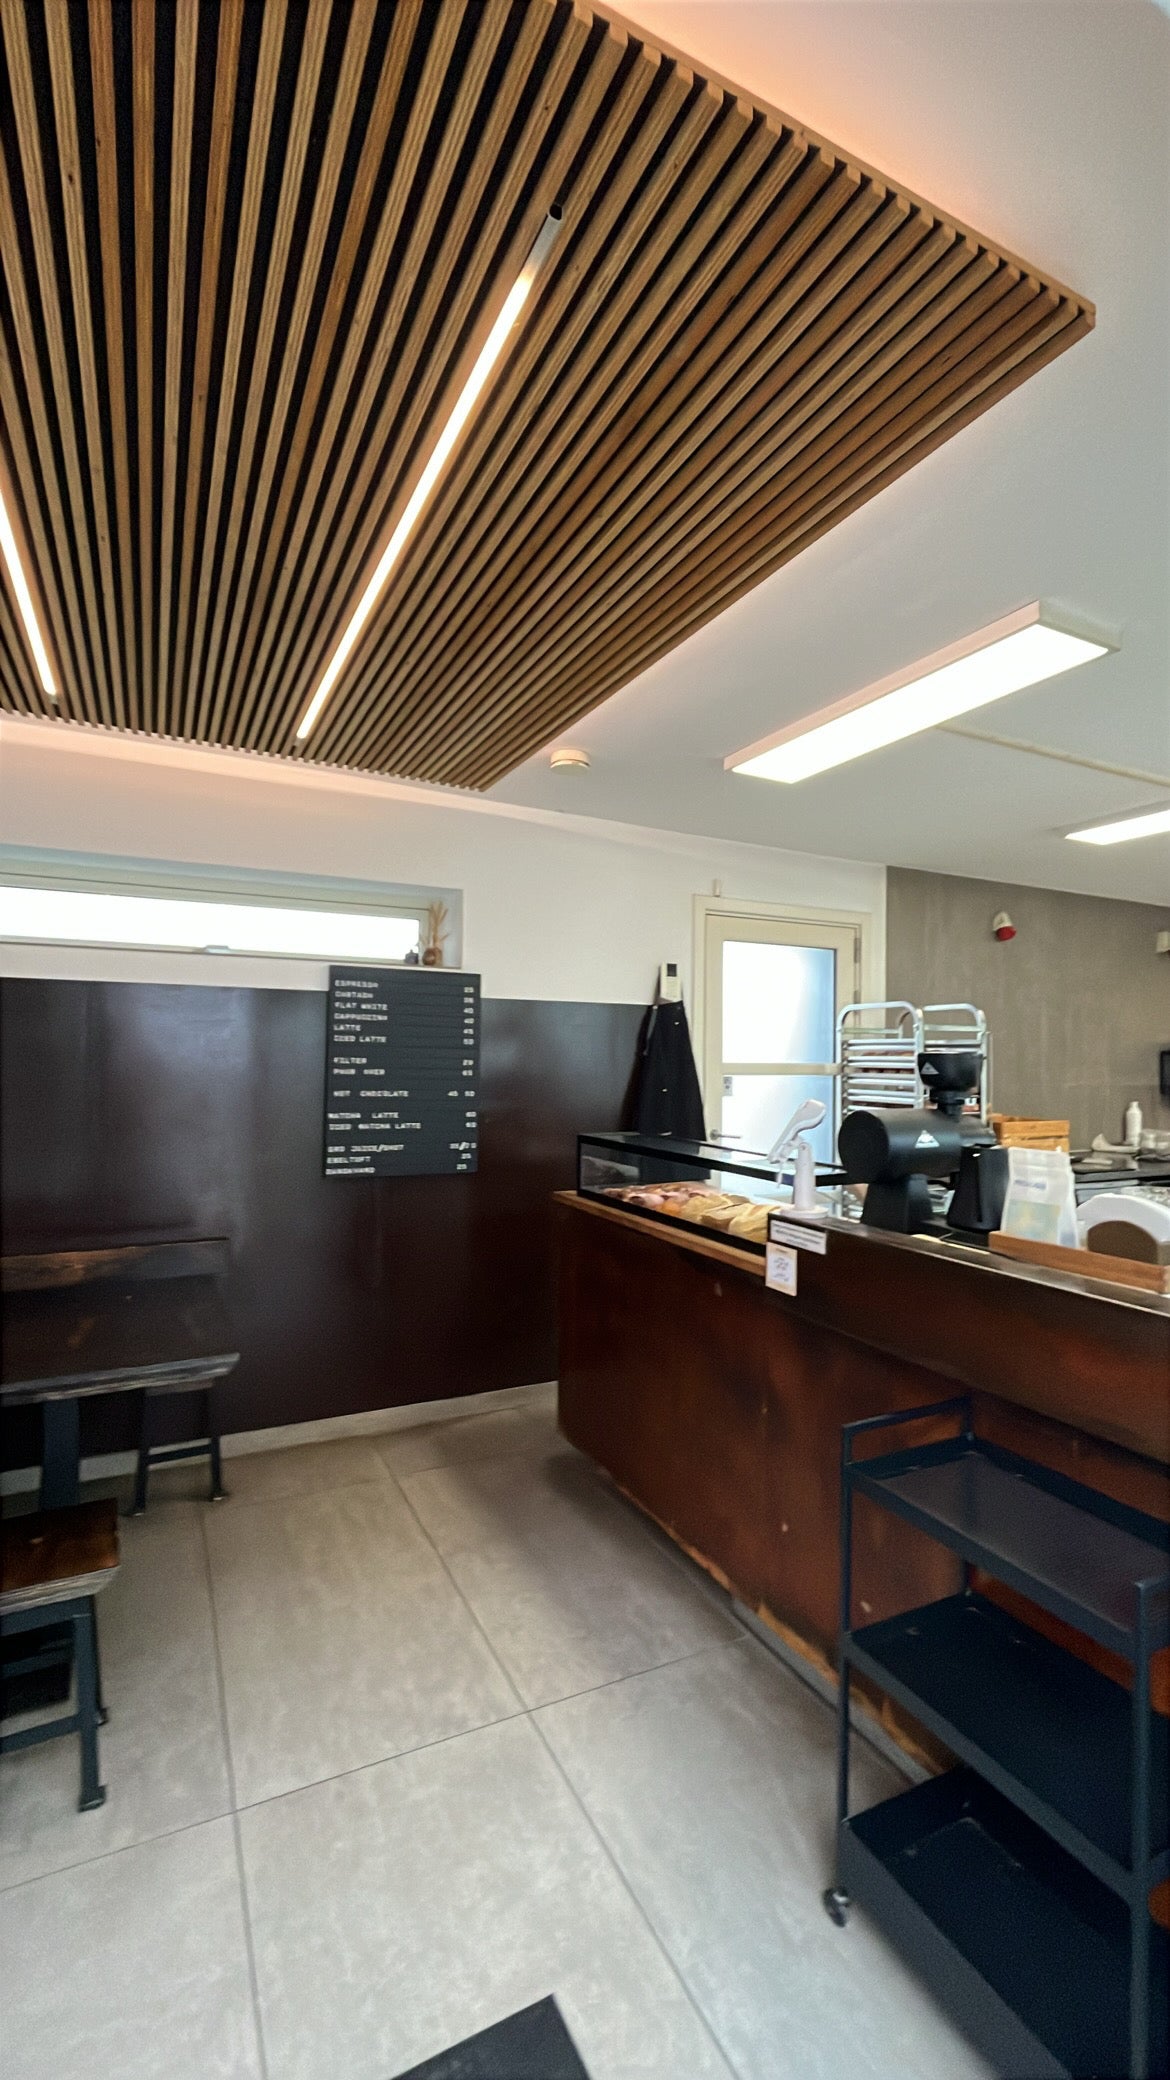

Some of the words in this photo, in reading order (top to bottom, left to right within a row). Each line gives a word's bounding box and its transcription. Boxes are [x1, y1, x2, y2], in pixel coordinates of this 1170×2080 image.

[335, 1001, 357, 1009] FLAT
[334, 1023, 361, 1031] LATTE
[334, 1034, 356, 1042] ICED
[359, 1035, 386, 1043] LATTE
[333, 1056, 367, 1064] FILTER
[333, 1067, 356, 1075] POUR
[328, 1111, 361, 1119] MATCHA
